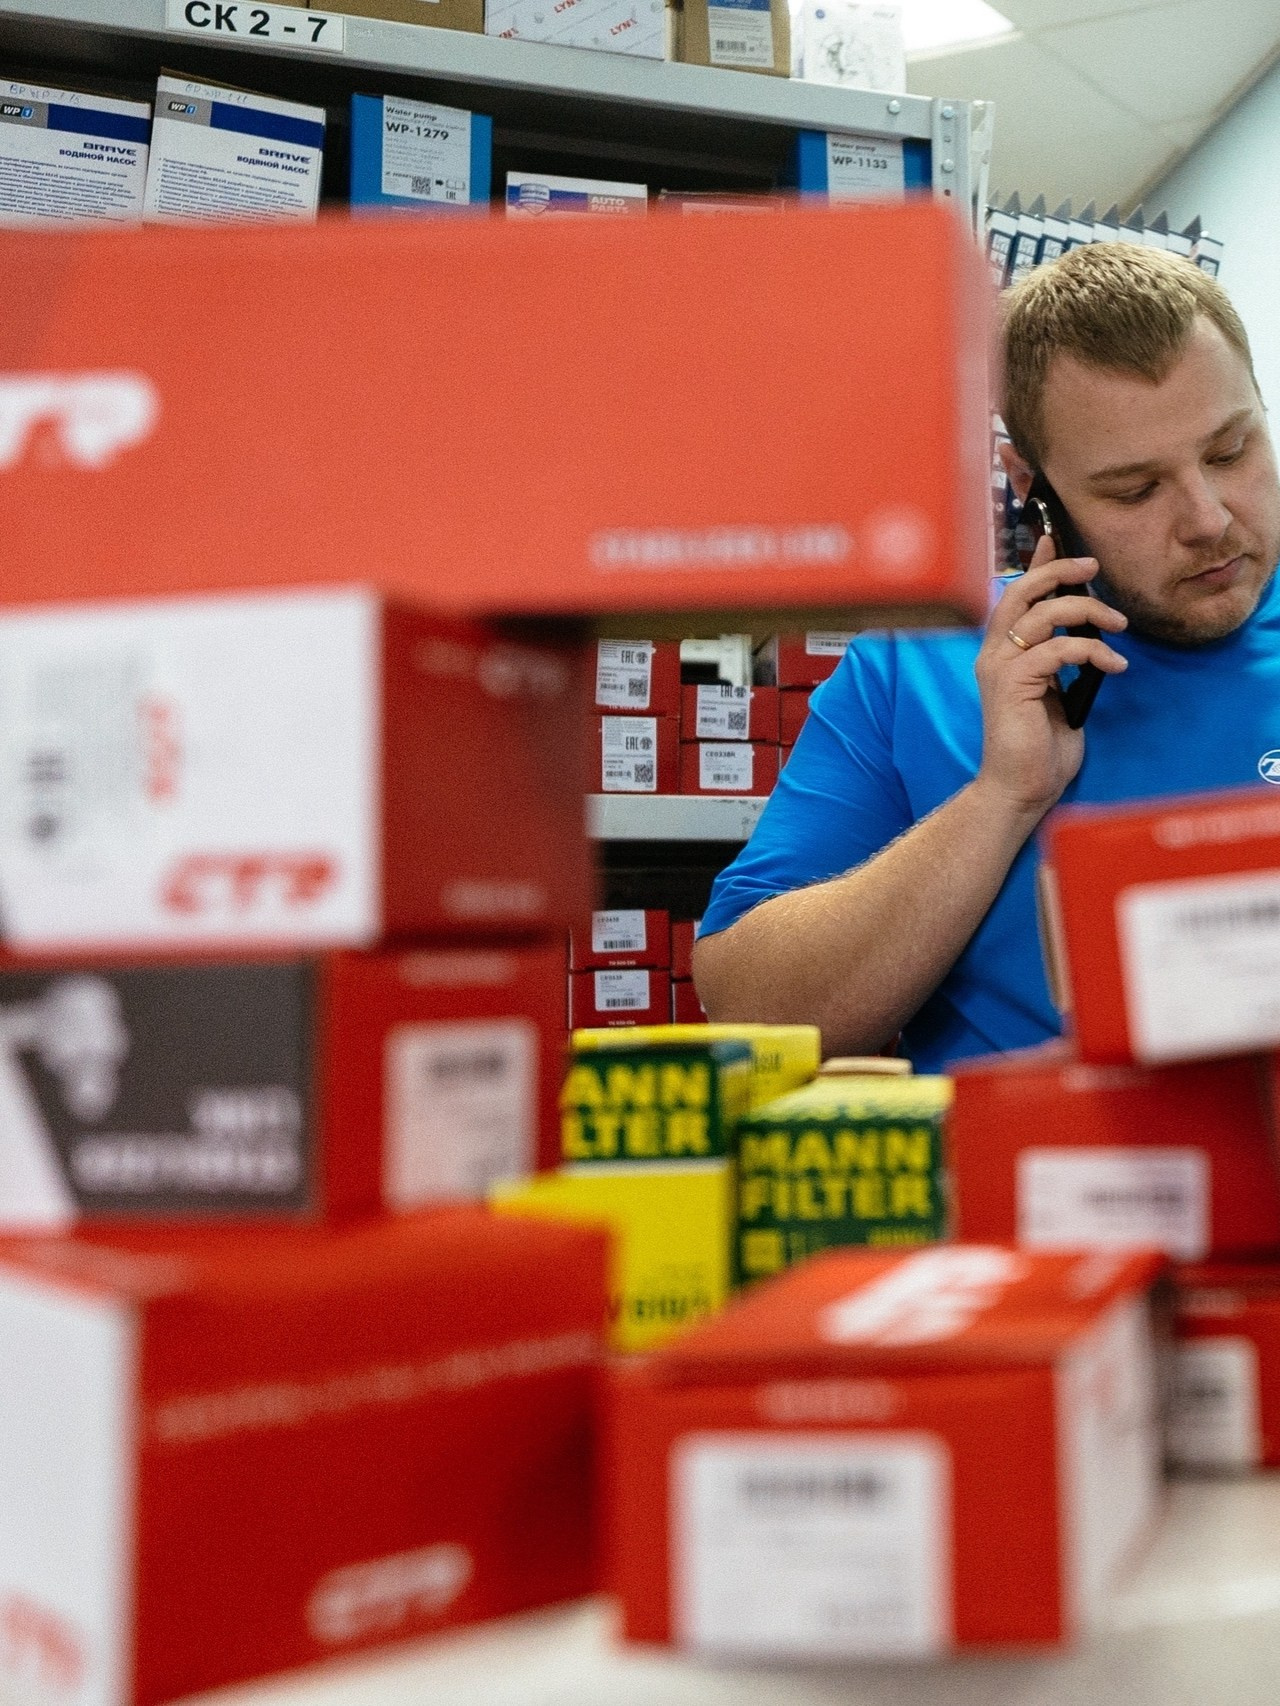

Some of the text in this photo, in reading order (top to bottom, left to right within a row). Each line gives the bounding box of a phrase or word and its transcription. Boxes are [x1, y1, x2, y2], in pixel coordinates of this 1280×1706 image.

[250, 9, 270, 36] 2
[307, 16, 328, 43] 7
[3, 105, 21, 116] WP
[170, 102, 186, 112] WP
[385, 106, 438, 122] Water pump
[385, 121, 449, 140] WP-1279
[59, 149, 137, 167] ВОДЯНОЙ НАСОС
[83, 142, 137, 157] BRAVE
[258, 148, 312, 165] BRAVE
[236, 155, 310, 176] ВОДЯНОЙ НАСОС
[832, 156, 888, 169] WP-1133
[590, 196, 625, 206] AUTO
[564, 1062, 712, 1110] ANN
[562, 1110, 711, 1159] LTER
[740, 1128, 931, 1173] MANN
[740, 1174, 932, 1221] FILTER
